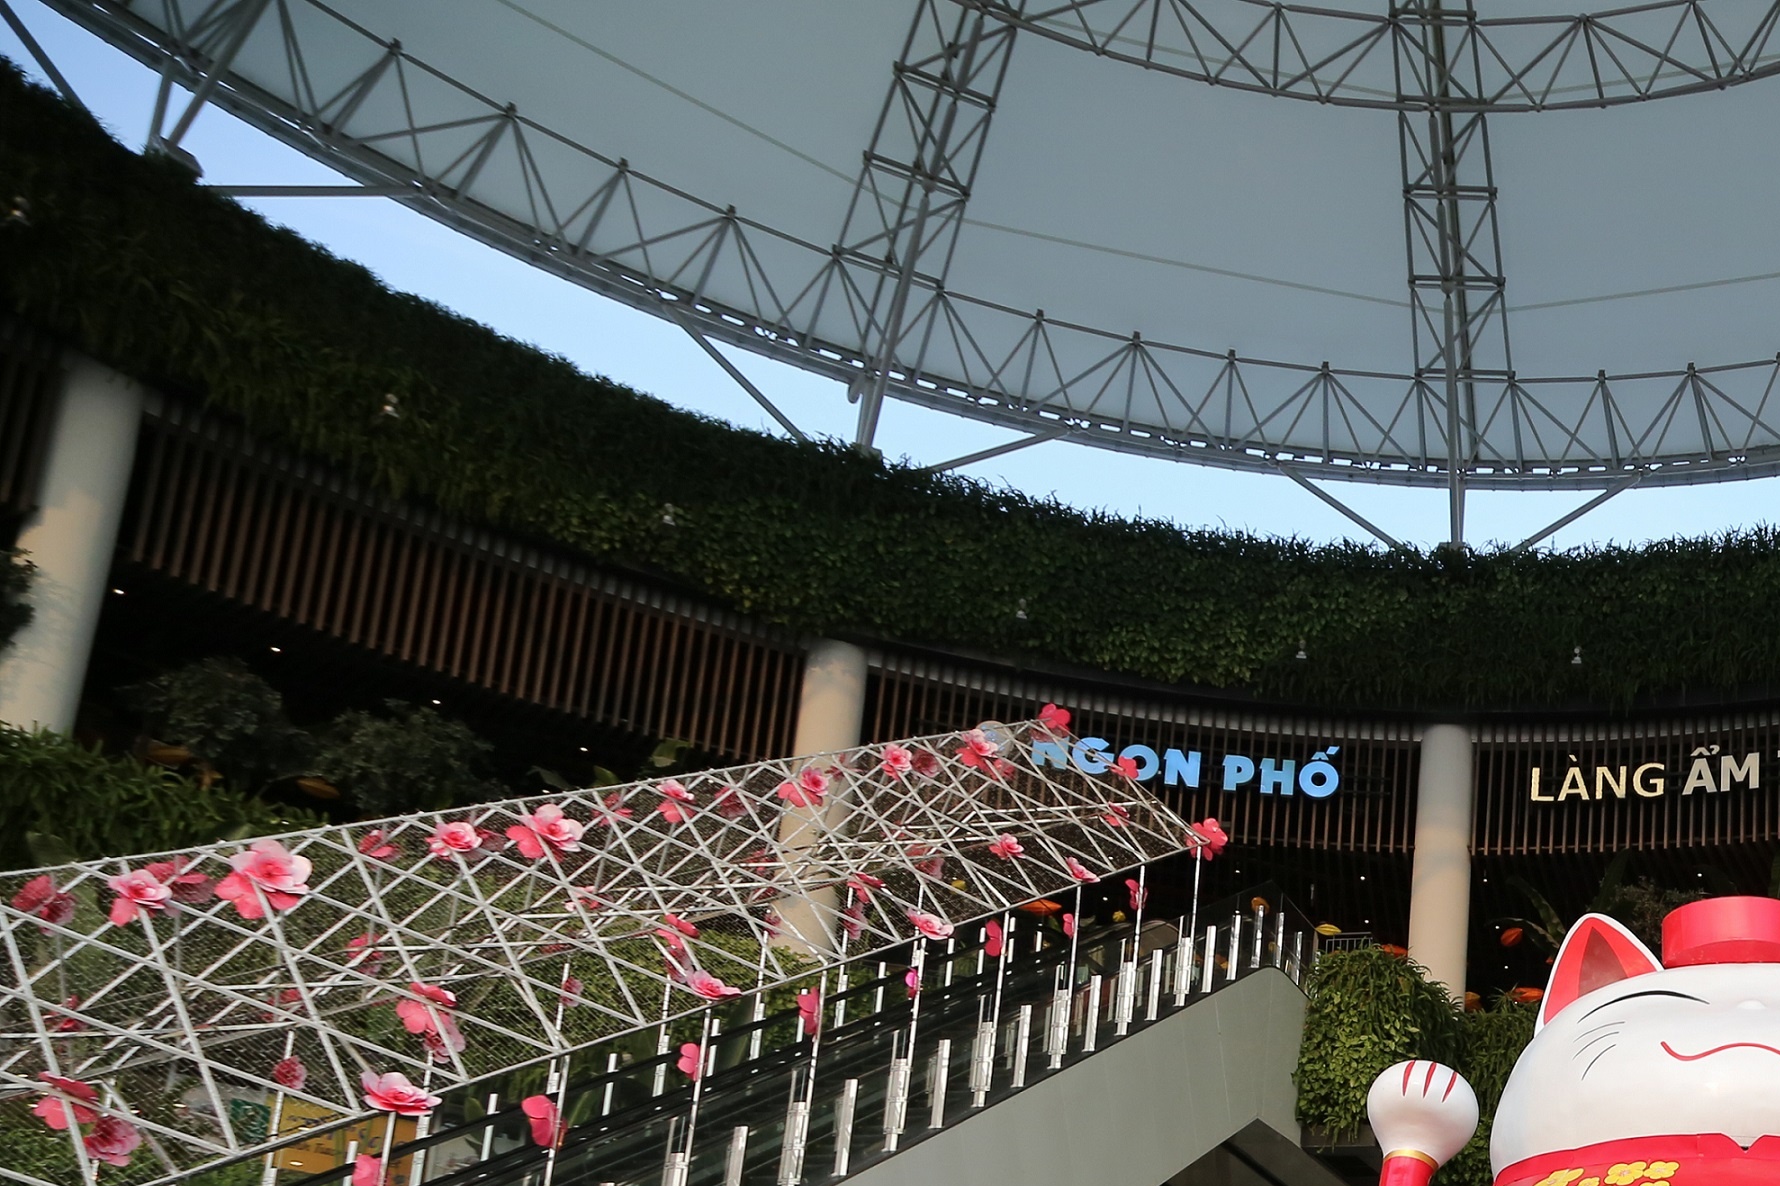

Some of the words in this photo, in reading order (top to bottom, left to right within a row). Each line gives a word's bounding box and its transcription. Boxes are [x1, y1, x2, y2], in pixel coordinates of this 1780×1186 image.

[1222, 745, 1340, 799] PHỐ
[1530, 754, 1665, 802] LÀNG
[1681, 744, 1760, 796] ẨM
